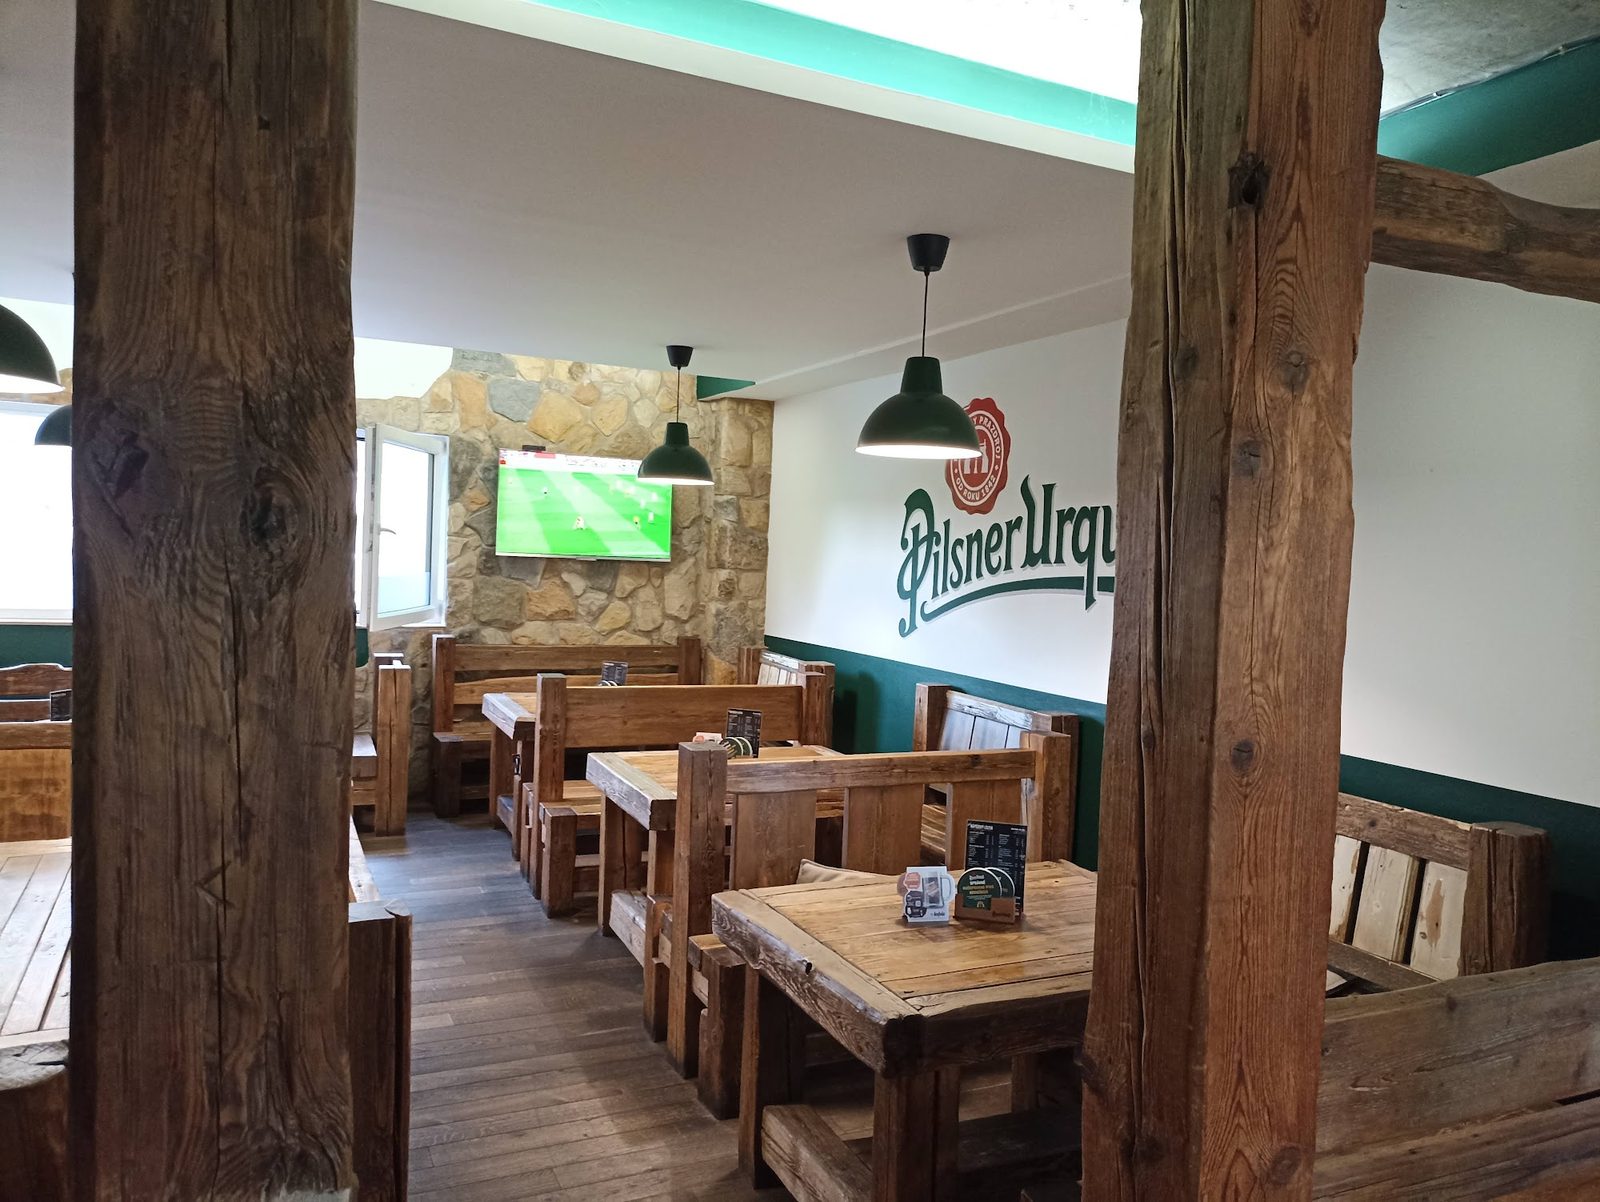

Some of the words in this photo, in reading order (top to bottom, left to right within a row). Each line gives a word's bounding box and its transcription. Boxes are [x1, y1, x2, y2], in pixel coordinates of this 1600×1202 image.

[979, 416, 1001, 459] PRAZDROJ
[955, 477, 964, 491] OD
[963, 490, 980, 501] ROKU
[981, 475, 997, 497] 1842
[897, 488, 1023, 638] Pilsner
